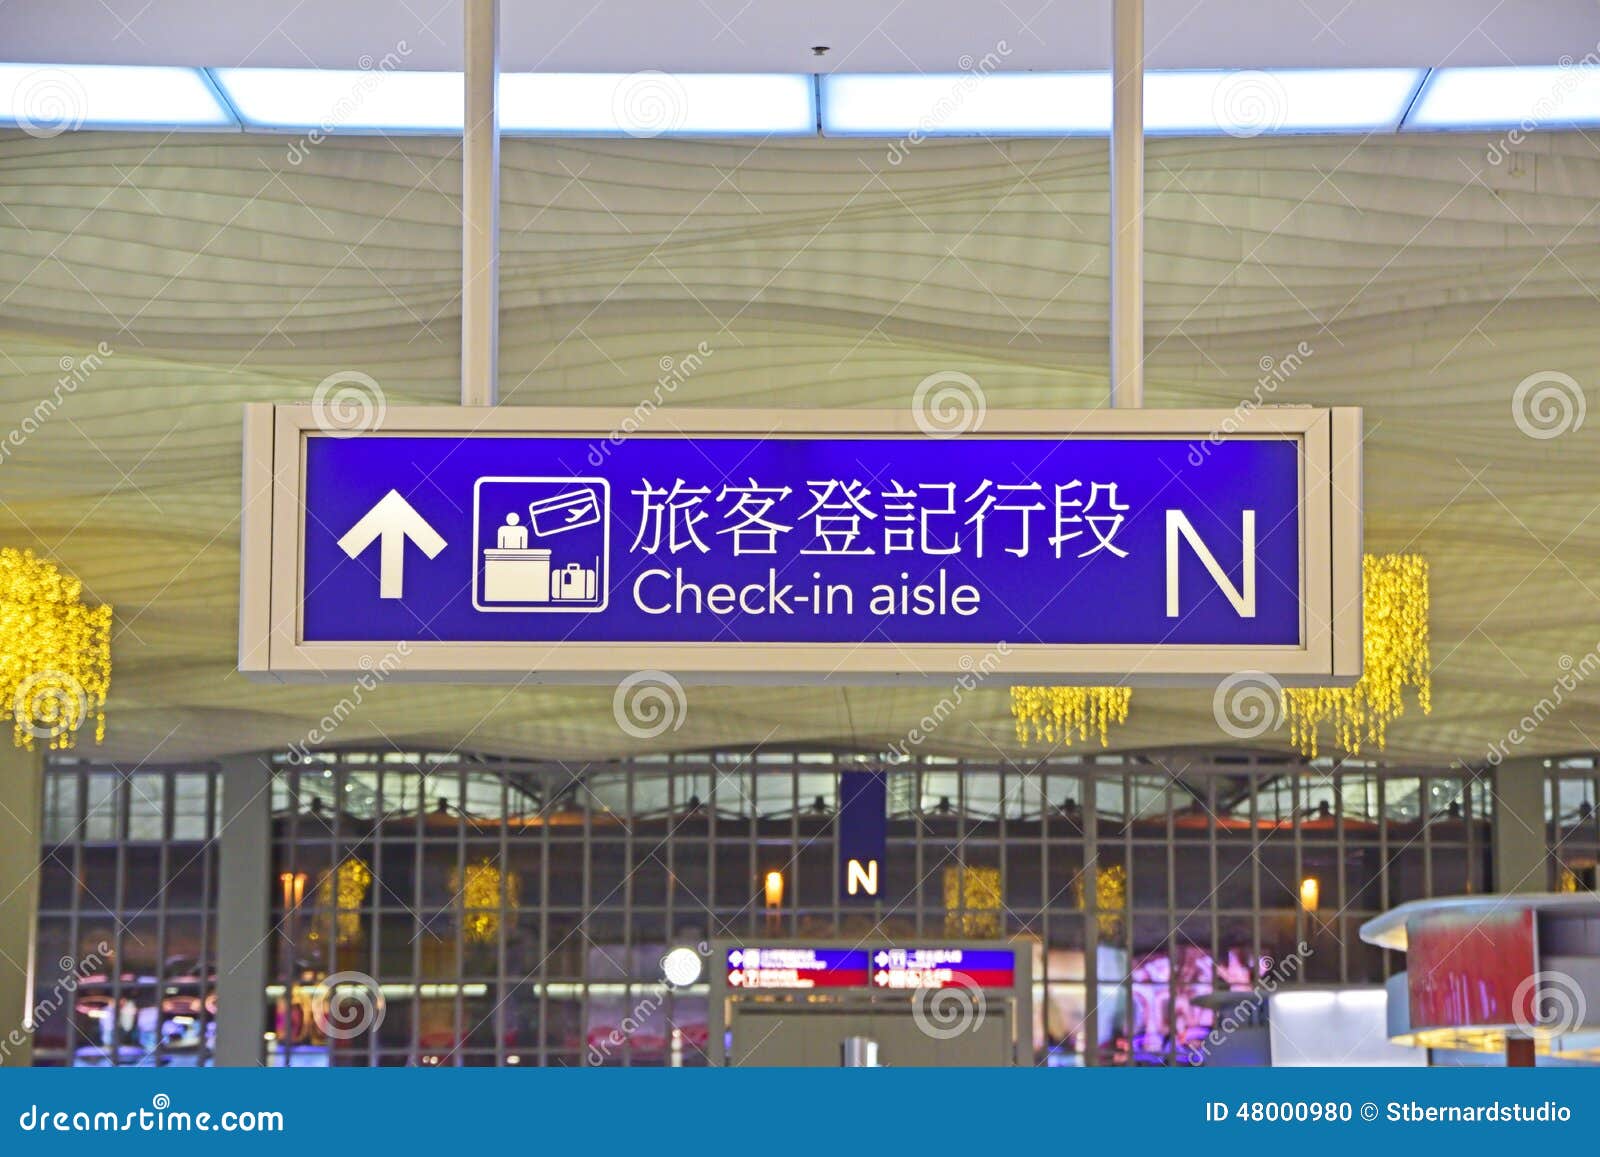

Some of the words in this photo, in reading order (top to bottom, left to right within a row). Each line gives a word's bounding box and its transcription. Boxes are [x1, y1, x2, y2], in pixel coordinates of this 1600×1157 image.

[629, 477, 1130, 559] 旅客登記行段
[633, 567, 853, 616] Check-in
[869, 569, 981, 616] aisle
[1165, 509, 1256, 618] N
[847, 859, 878, 896] N
